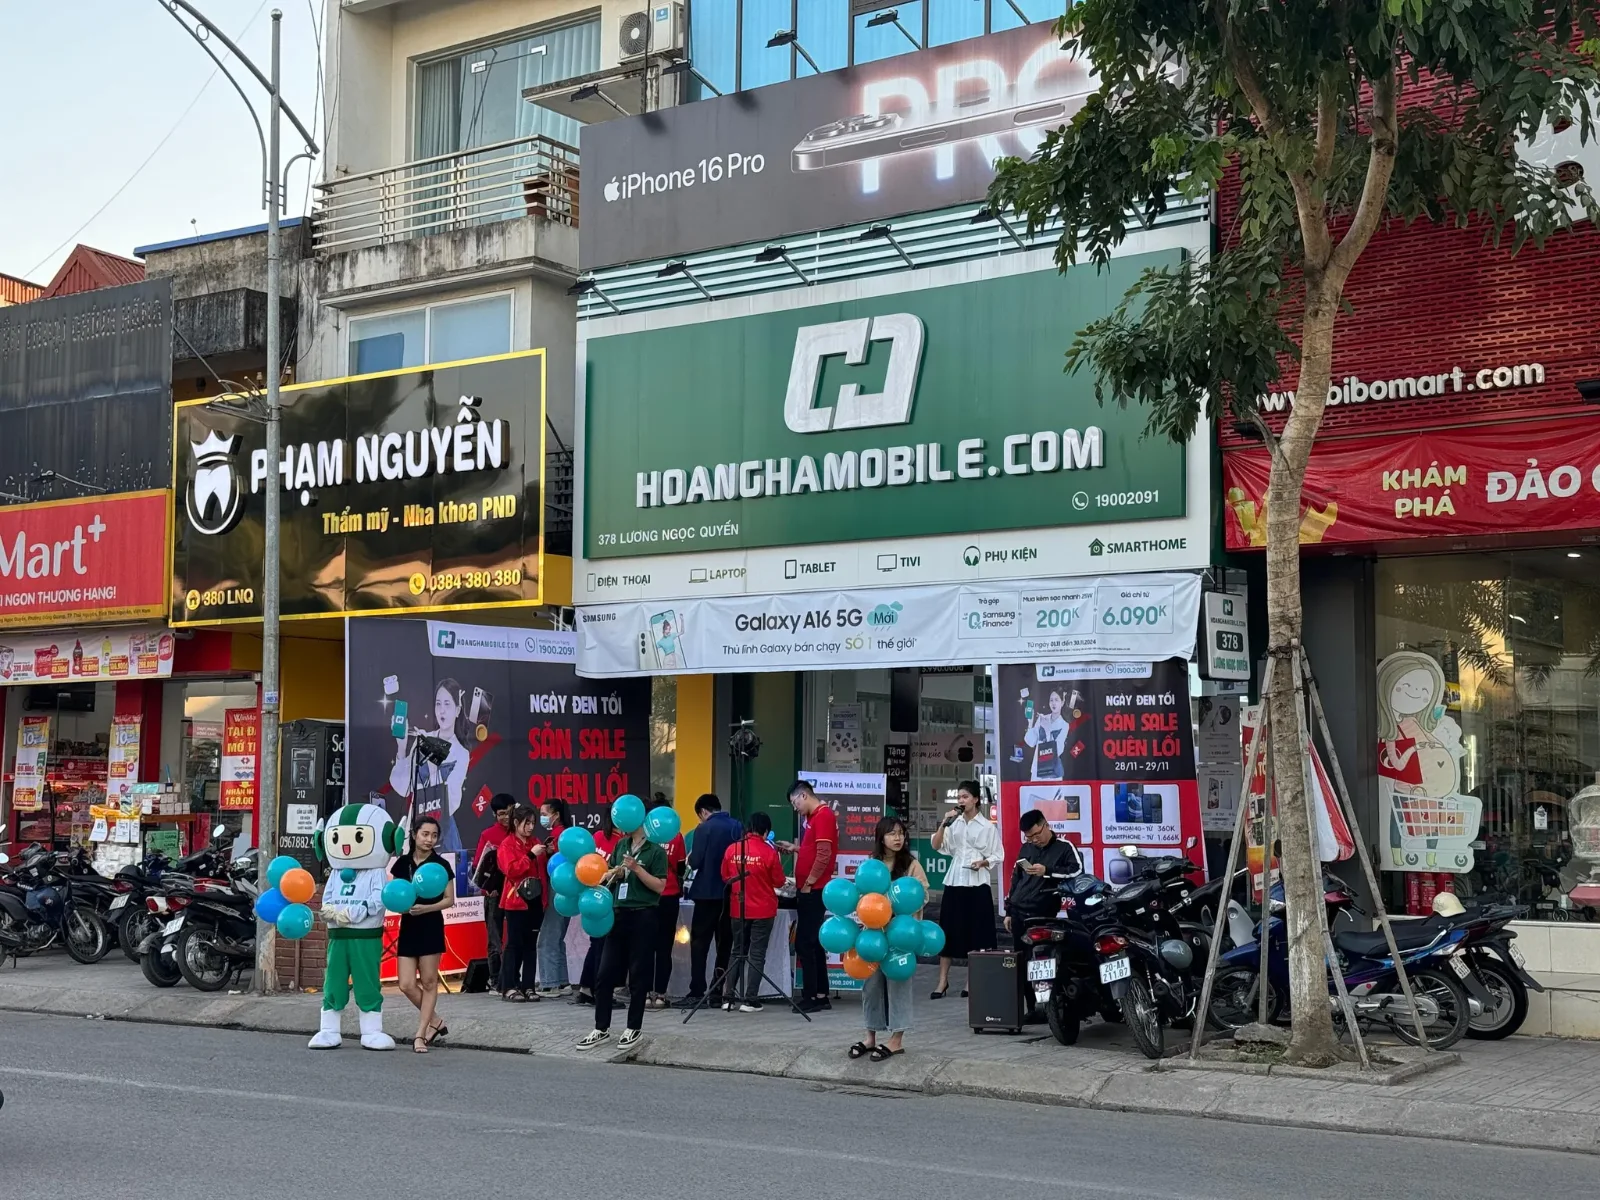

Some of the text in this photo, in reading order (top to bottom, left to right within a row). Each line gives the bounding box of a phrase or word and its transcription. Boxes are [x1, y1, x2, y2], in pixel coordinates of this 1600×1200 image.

[622, 153, 765, 199] iPhone 16 Pro
[251, 395, 503, 507] PHẠM NGUYỄN
[636, 425, 1105, 508] HOANGHAMOBILE.COM
[1382, 460, 1467, 491] KHÁM
[1485, 458, 1582, 503] ĐẢO
[1094, 490, 1160, 507] 19002091
[1395, 489, 1456, 519] PHÁ
[322, 505, 363, 535] Thẩm
[366, 508, 389, 532] mỹ
[404, 503, 434, 527] Nha
[438, 500, 477, 524] khoa
[481, 494, 517, 520] PND
[598, 520, 739, 545] 378 LƯƠNG NGỌC QUYẾN
[1106, 538, 1187, 554] SMARTHOME
[900, 556, 921, 567] TIVI
[984, 547, 1038, 563] PHỤ KIỆN
[709, 568, 747, 580] LAPTOP
[800, 562, 836, 574] TABLET
[430, 568, 521, 592] 0384 380 380
[597, 574, 651, 588] ĐIỆN THOẠI
[5, 592, 35, 607] NGON
[83, 585, 117, 603] HẠNG!
[204, 587, 254, 607] 380 LNQ
[1036, 594, 1049, 602] kèm
[1062, 593, 1081, 601] nhanh
[582, 612, 617, 624] SAMSUNG
[735, 608, 894, 634] Galaxy A16 5G Mới
[982, 611, 1016, 620] Samsung
[456, 637, 520, 649] HOANGHAMOBILE.COM
[538, 644, 575, 656] 1900.2091
[722, 645, 741, 655] Thủ
[741, 643, 759, 654] lĩnh
[759, 642, 792, 655] Galaxy
[794, 641, 814, 652] bán
[816, 641, 841, 654] chạy
[844, 631, 864, 650] SỐ
[867, 637, 873, 650] 1
[877, 637, 895, 649] thế
[1034, 640, 1049, 649] ngày
[1221, 633, 1239, 650] 378
[530, 690, 622, 715] NGÀY ĐEN TỐI
[1105, 690, 1176, 706] NGÀY ĐEN TỐI
[1104, 709, 1179, 732] SĂN SALE
[227, 726, 244, 739] TẠI
[528, 720, 626, 760] SĂN SALE
[887, 746, 906, 757] Tặng
[1102, 735, 1148, 760] QUÊN
[1152, 732, 1181, 757] LỐI
[1115, 761, 1138, 772] 28/11
[1145, 761, 1169, 772] 29/11
[528, 761, 629, 809] QUÊN LỐI
[819, 780, 882, 790] HOÀNG HÀ MOBILE
[296, 790, 306, 799] 212
[446, 910, 479, 919] SMARTPHONE
